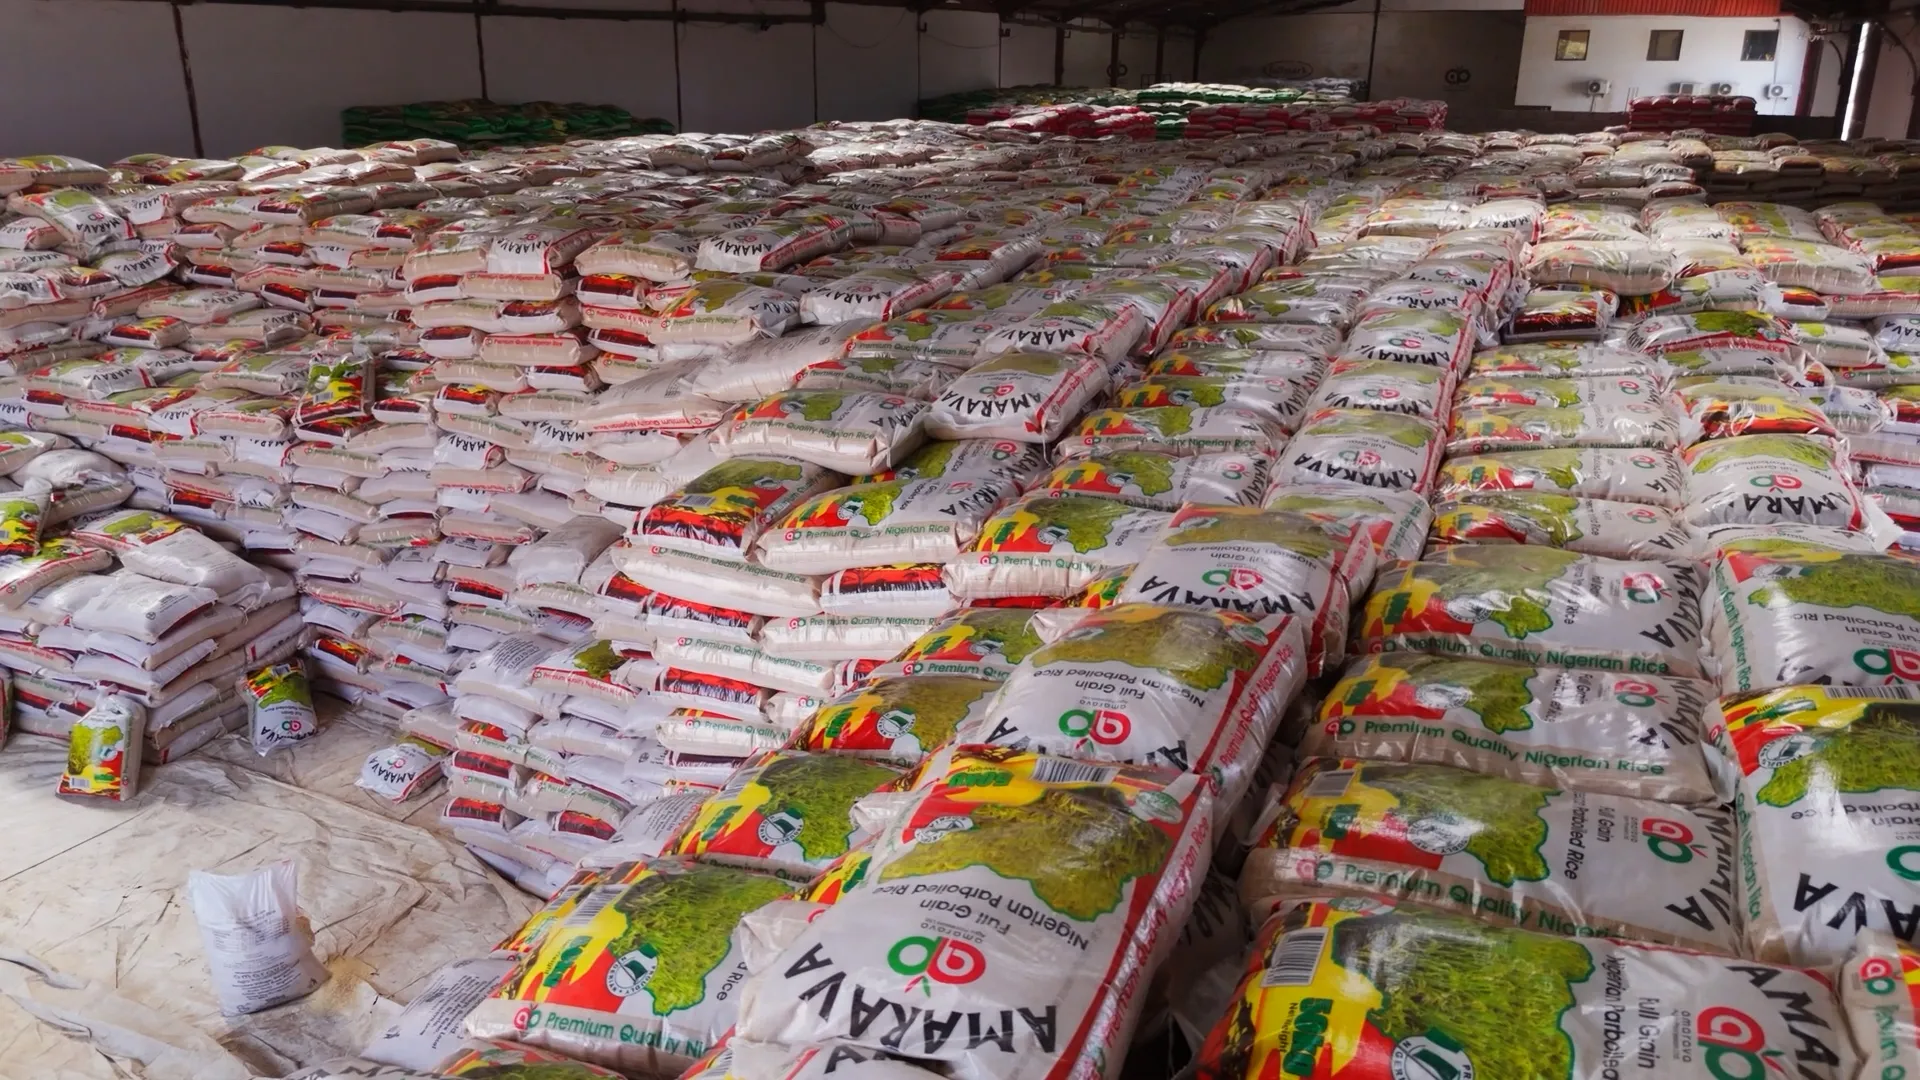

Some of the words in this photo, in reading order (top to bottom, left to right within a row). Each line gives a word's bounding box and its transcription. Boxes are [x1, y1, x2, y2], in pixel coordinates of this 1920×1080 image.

[928, 524, 950, 533] Rice
[1545, 651, 1624, 670] Nigerian
[1629, 658, 1669, 674] Rice
[1363, 719, 1445, 738] Premium
[1451, 729, 1519, 760] Quality
[1524, 750, 1610, 773] Nigerian
[1563, 849, 1586, 882] Rice
[1343, 864, 1442, 897] Premium
[1449, 885, 1533, 926] Quality
[913, 883, 1003, 908] Parboiled
[1008, 899, 1090, 950] Nigerian
[919, 899, 973, 918] Grain
[976, 912, 1012, 936] Full
[715, 971, 745, 1002] Rice
[784, 941, 1058, 1055] AMARAVA
[544, 1012, 615, 1040] Premium
